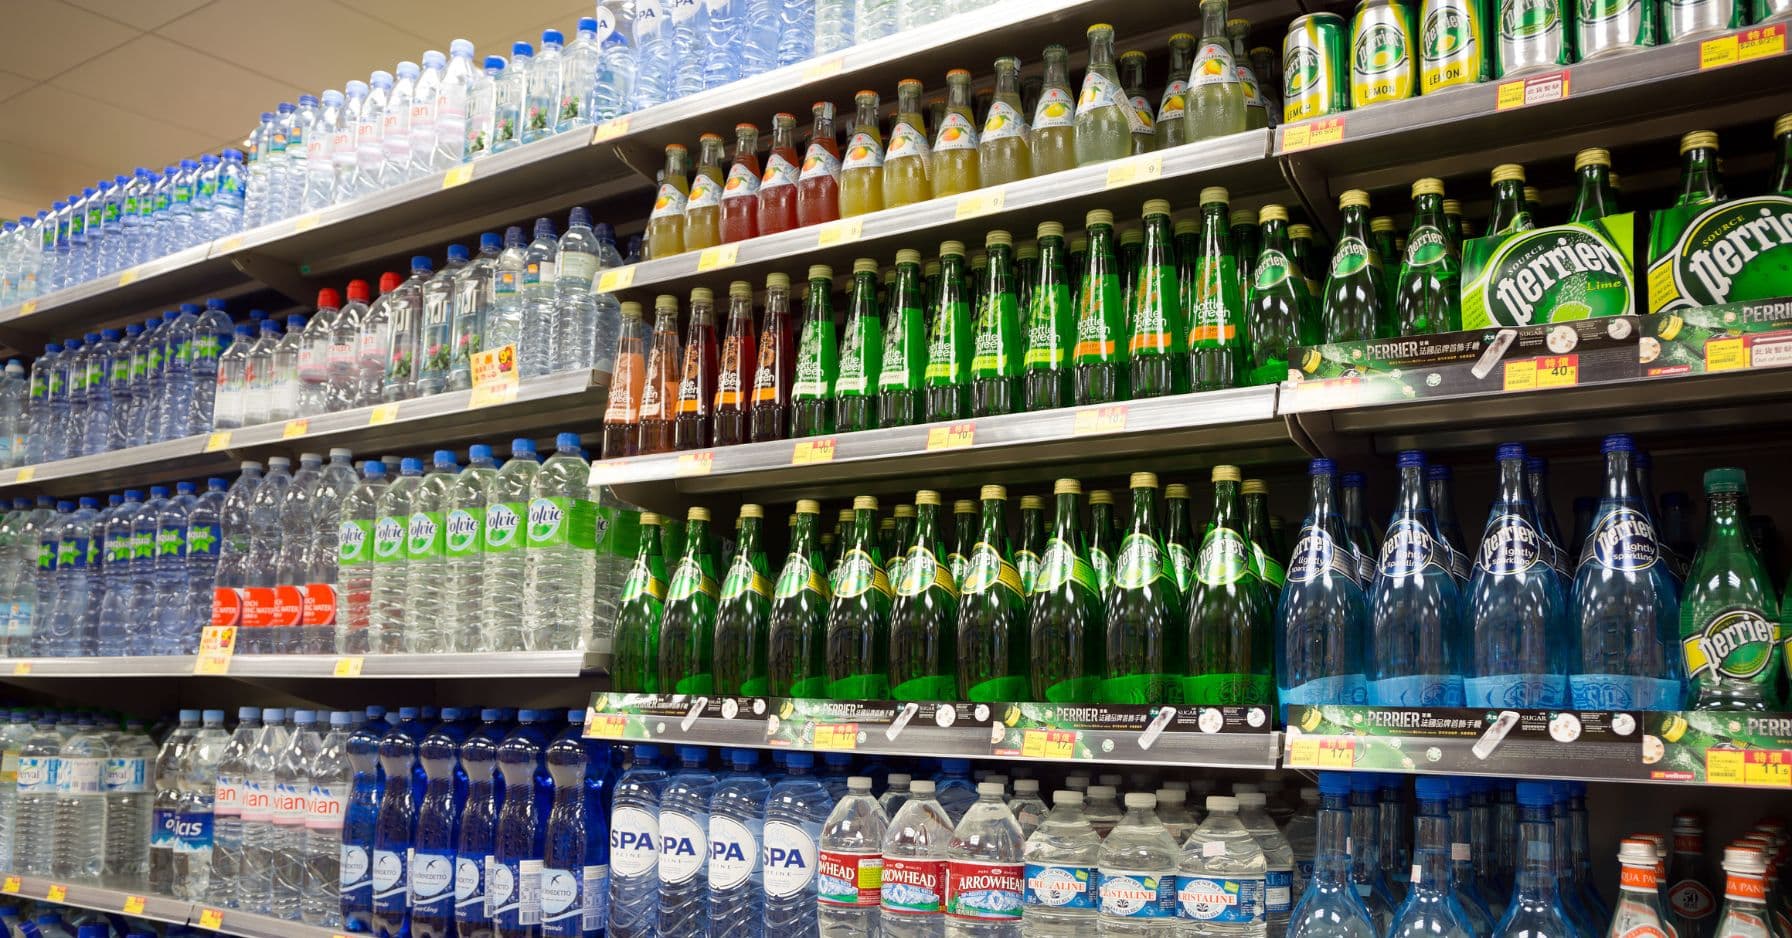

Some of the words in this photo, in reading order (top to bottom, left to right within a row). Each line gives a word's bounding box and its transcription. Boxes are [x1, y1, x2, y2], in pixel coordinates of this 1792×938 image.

[1702, 214, 1745, 247] SOURCE
[1407, 231, 1443, 259] perrier
[1332, 242, 1368, 271] perrier
[1508, 245, 1545, 275] SOURCE
[1255, 257, 1286, 281] perrier
[1496, 237, 1618, 326] perrier
[1586, 280, 1622, 294] Lime
[1366, 341, 1419, 361] PERRIER
[1551, 365, 1568, 377] 40
[488, 506, 520, 532] olvic
[530, 497, 564, 522] olvic
[341, 527, 366, 547] olvic
[378, 525, 404, 544] olvic
[410, 522, 438, 542] olvic
[449, 516, 478, 539] olvic
[1381, 524, 1431, 570] perrier
[1483, 518, 1535, 570] perrier
[1598, 515, 1655, 563] perrier
[1612, 552, 1653, 562] sparkling
[1698, 614, 1777, 686] perrier
[1056, 707, 1099, 722] PERRIER
[1367, 711, 1421, 729] PERRIER
[1056, 741, 1069, 750] 17
[1331, 748, 1344, 759] 17
[271, 795, 306, 811] vian
[305, 798, 341, 814] vian
[611, 831, 655, 850] SPA
[659, 836, 697, 856] SPA
[708, 840, 751, 862] SPA
[764, 846, 806, 868] SPA
[817, 861, 855, 882] WHEAD
[881, 867, 936, 888] RROWHEAD
[1029, 880, 1086, 892] CRIALINE
